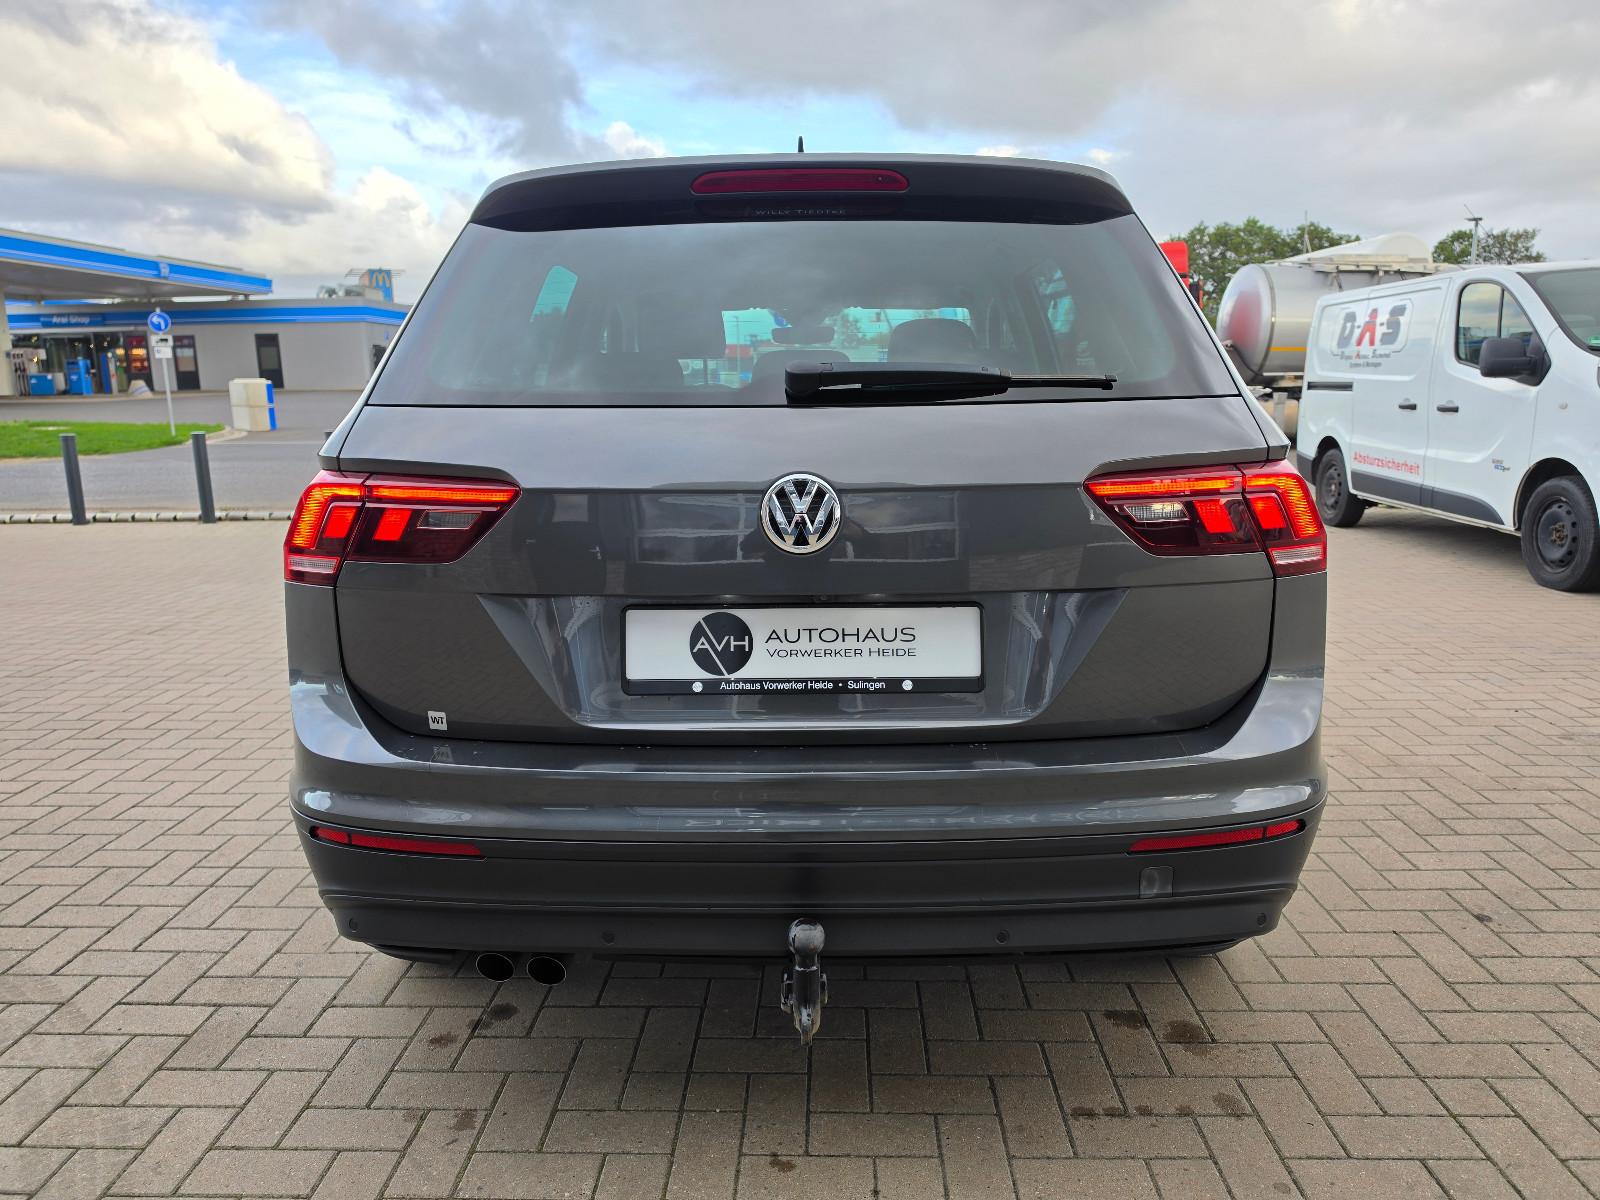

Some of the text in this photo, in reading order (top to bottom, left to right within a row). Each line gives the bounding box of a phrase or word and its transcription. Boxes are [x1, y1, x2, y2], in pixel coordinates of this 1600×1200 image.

[755, 208, 791, 216] WILLY
[764, 627, 917, 644] AUTOHAUS
[765, 647, 917, 659] VORWERKER HEIDE
[719, 680, 886, 691] Autohaus Vorwerker Heide Sulingen
[430, 715, 445, 725] WT
